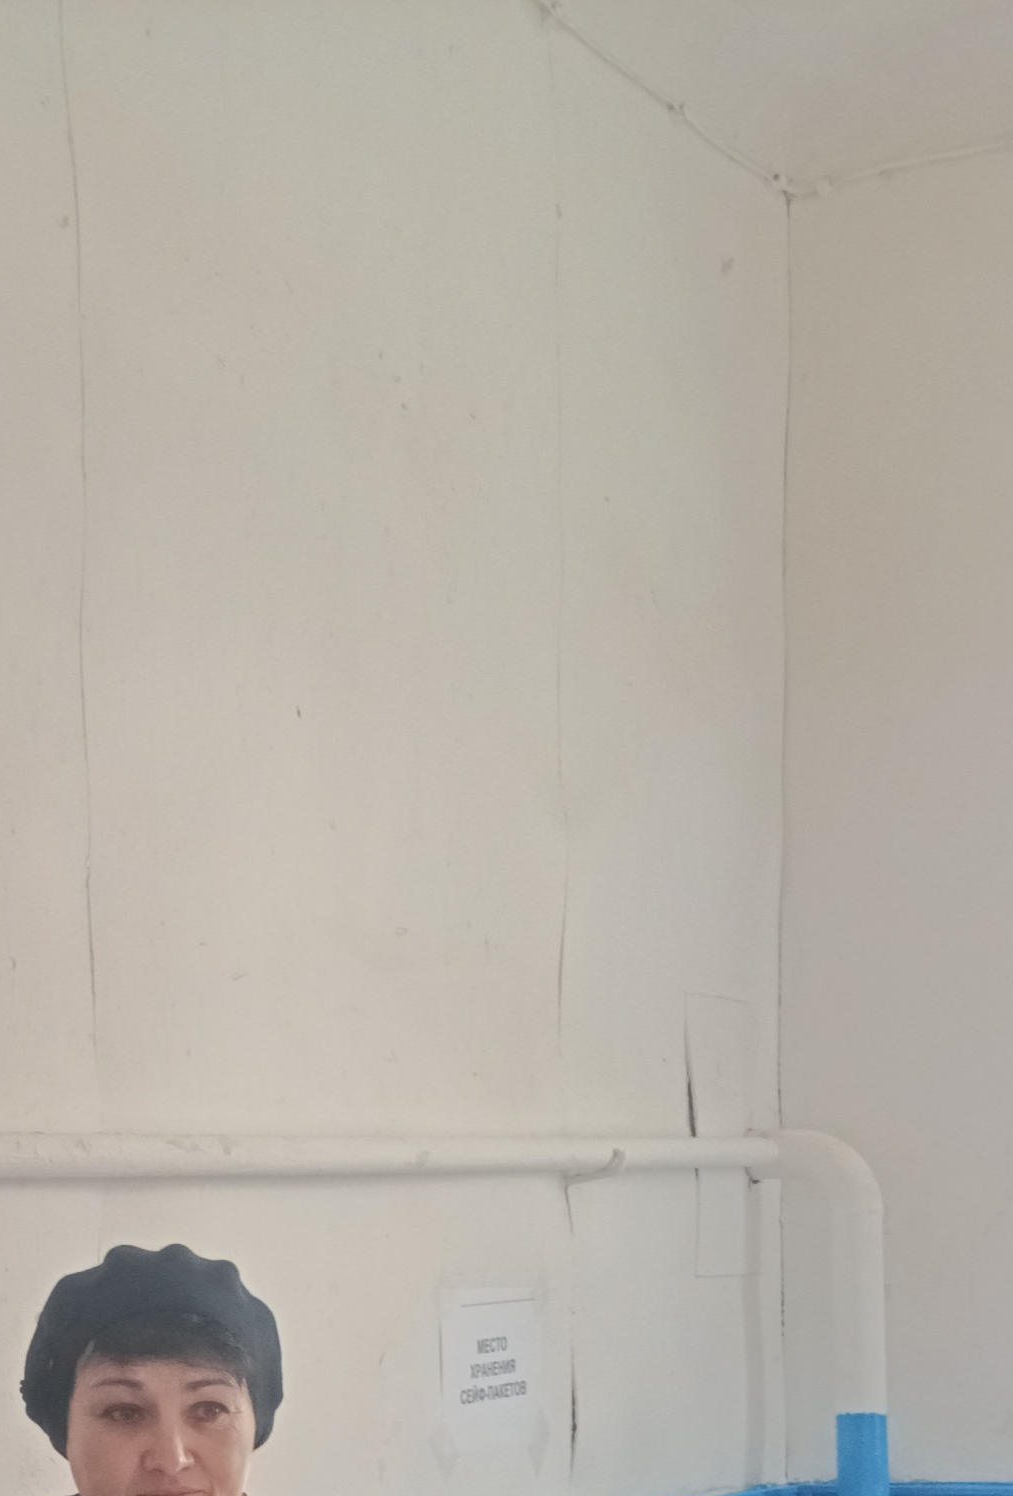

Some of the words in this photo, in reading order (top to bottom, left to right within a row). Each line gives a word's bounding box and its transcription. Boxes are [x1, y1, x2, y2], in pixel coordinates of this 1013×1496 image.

[476, 1336, 508, 1354] МЕСТО
[469, 1358, 516, 1379] ХРАНЕНИЯ
[460, 1380, 527, 1404] СЕЙФ-ПАКЕТОВ
